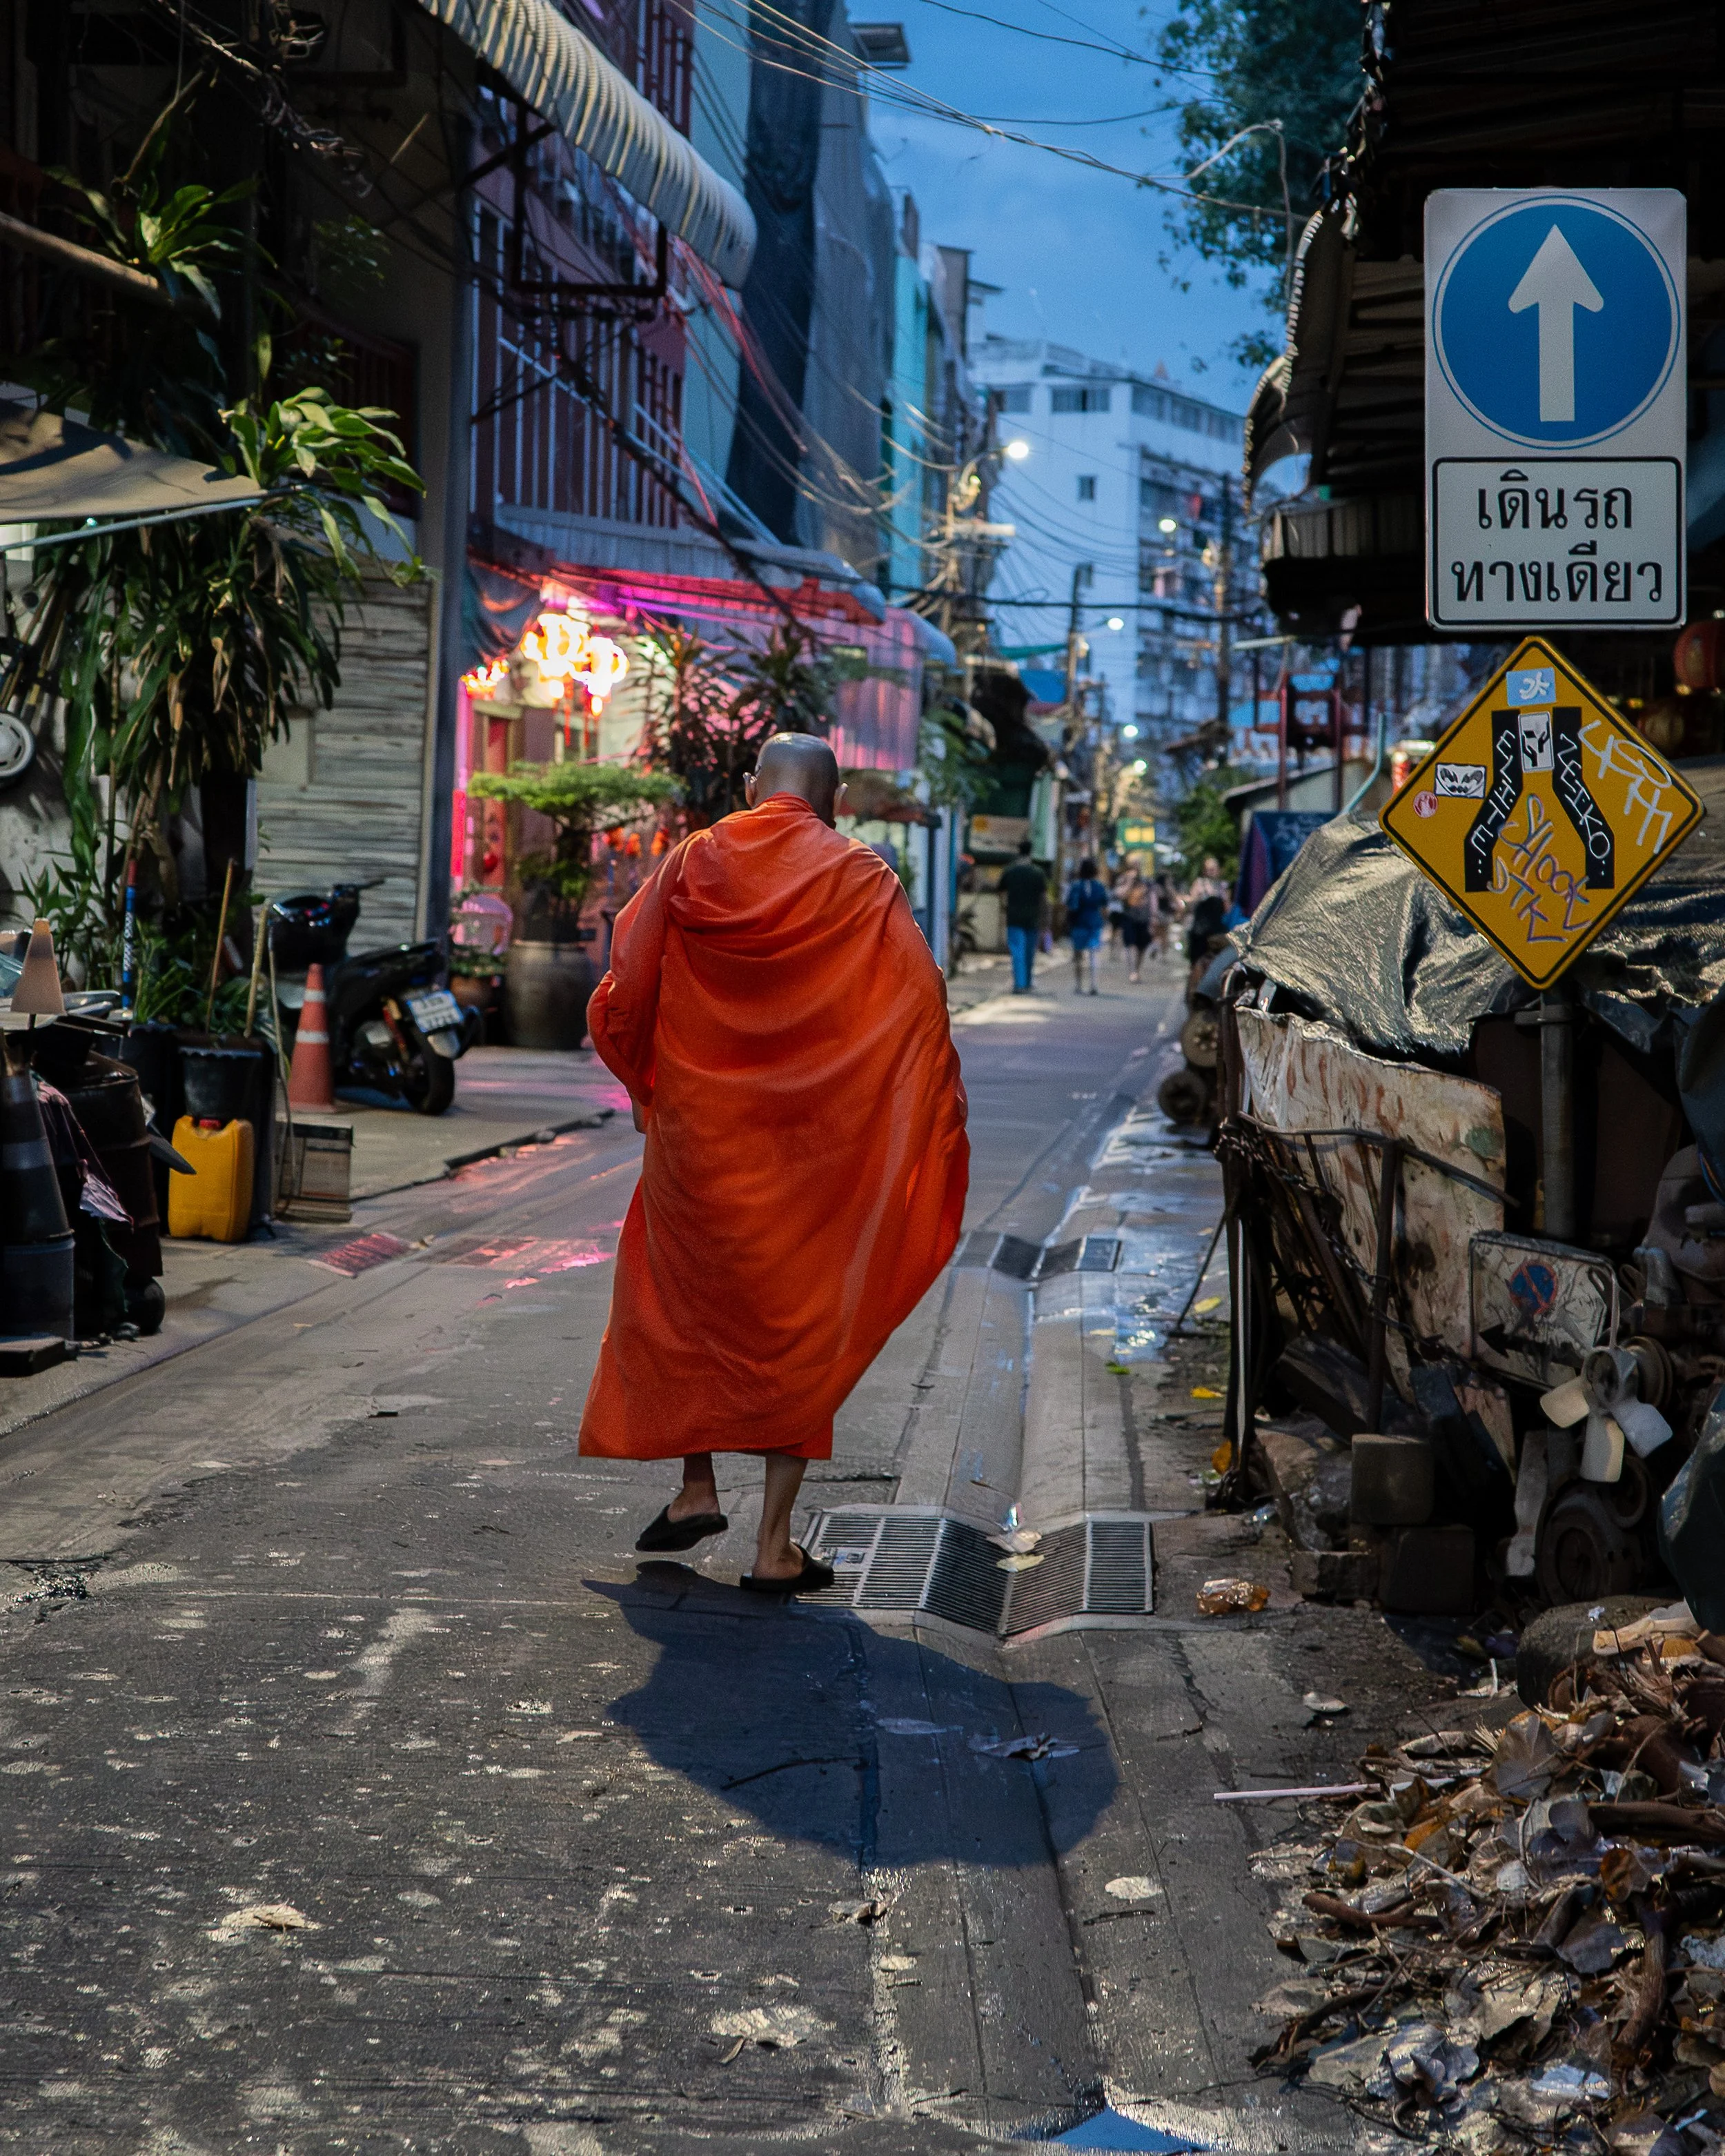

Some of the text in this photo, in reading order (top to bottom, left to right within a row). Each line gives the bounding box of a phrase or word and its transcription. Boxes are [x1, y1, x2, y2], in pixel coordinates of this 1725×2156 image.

[1478, 468, 1633, 529] เดินรถ
[1450, 540, 1663, 603] ทางเดียว
